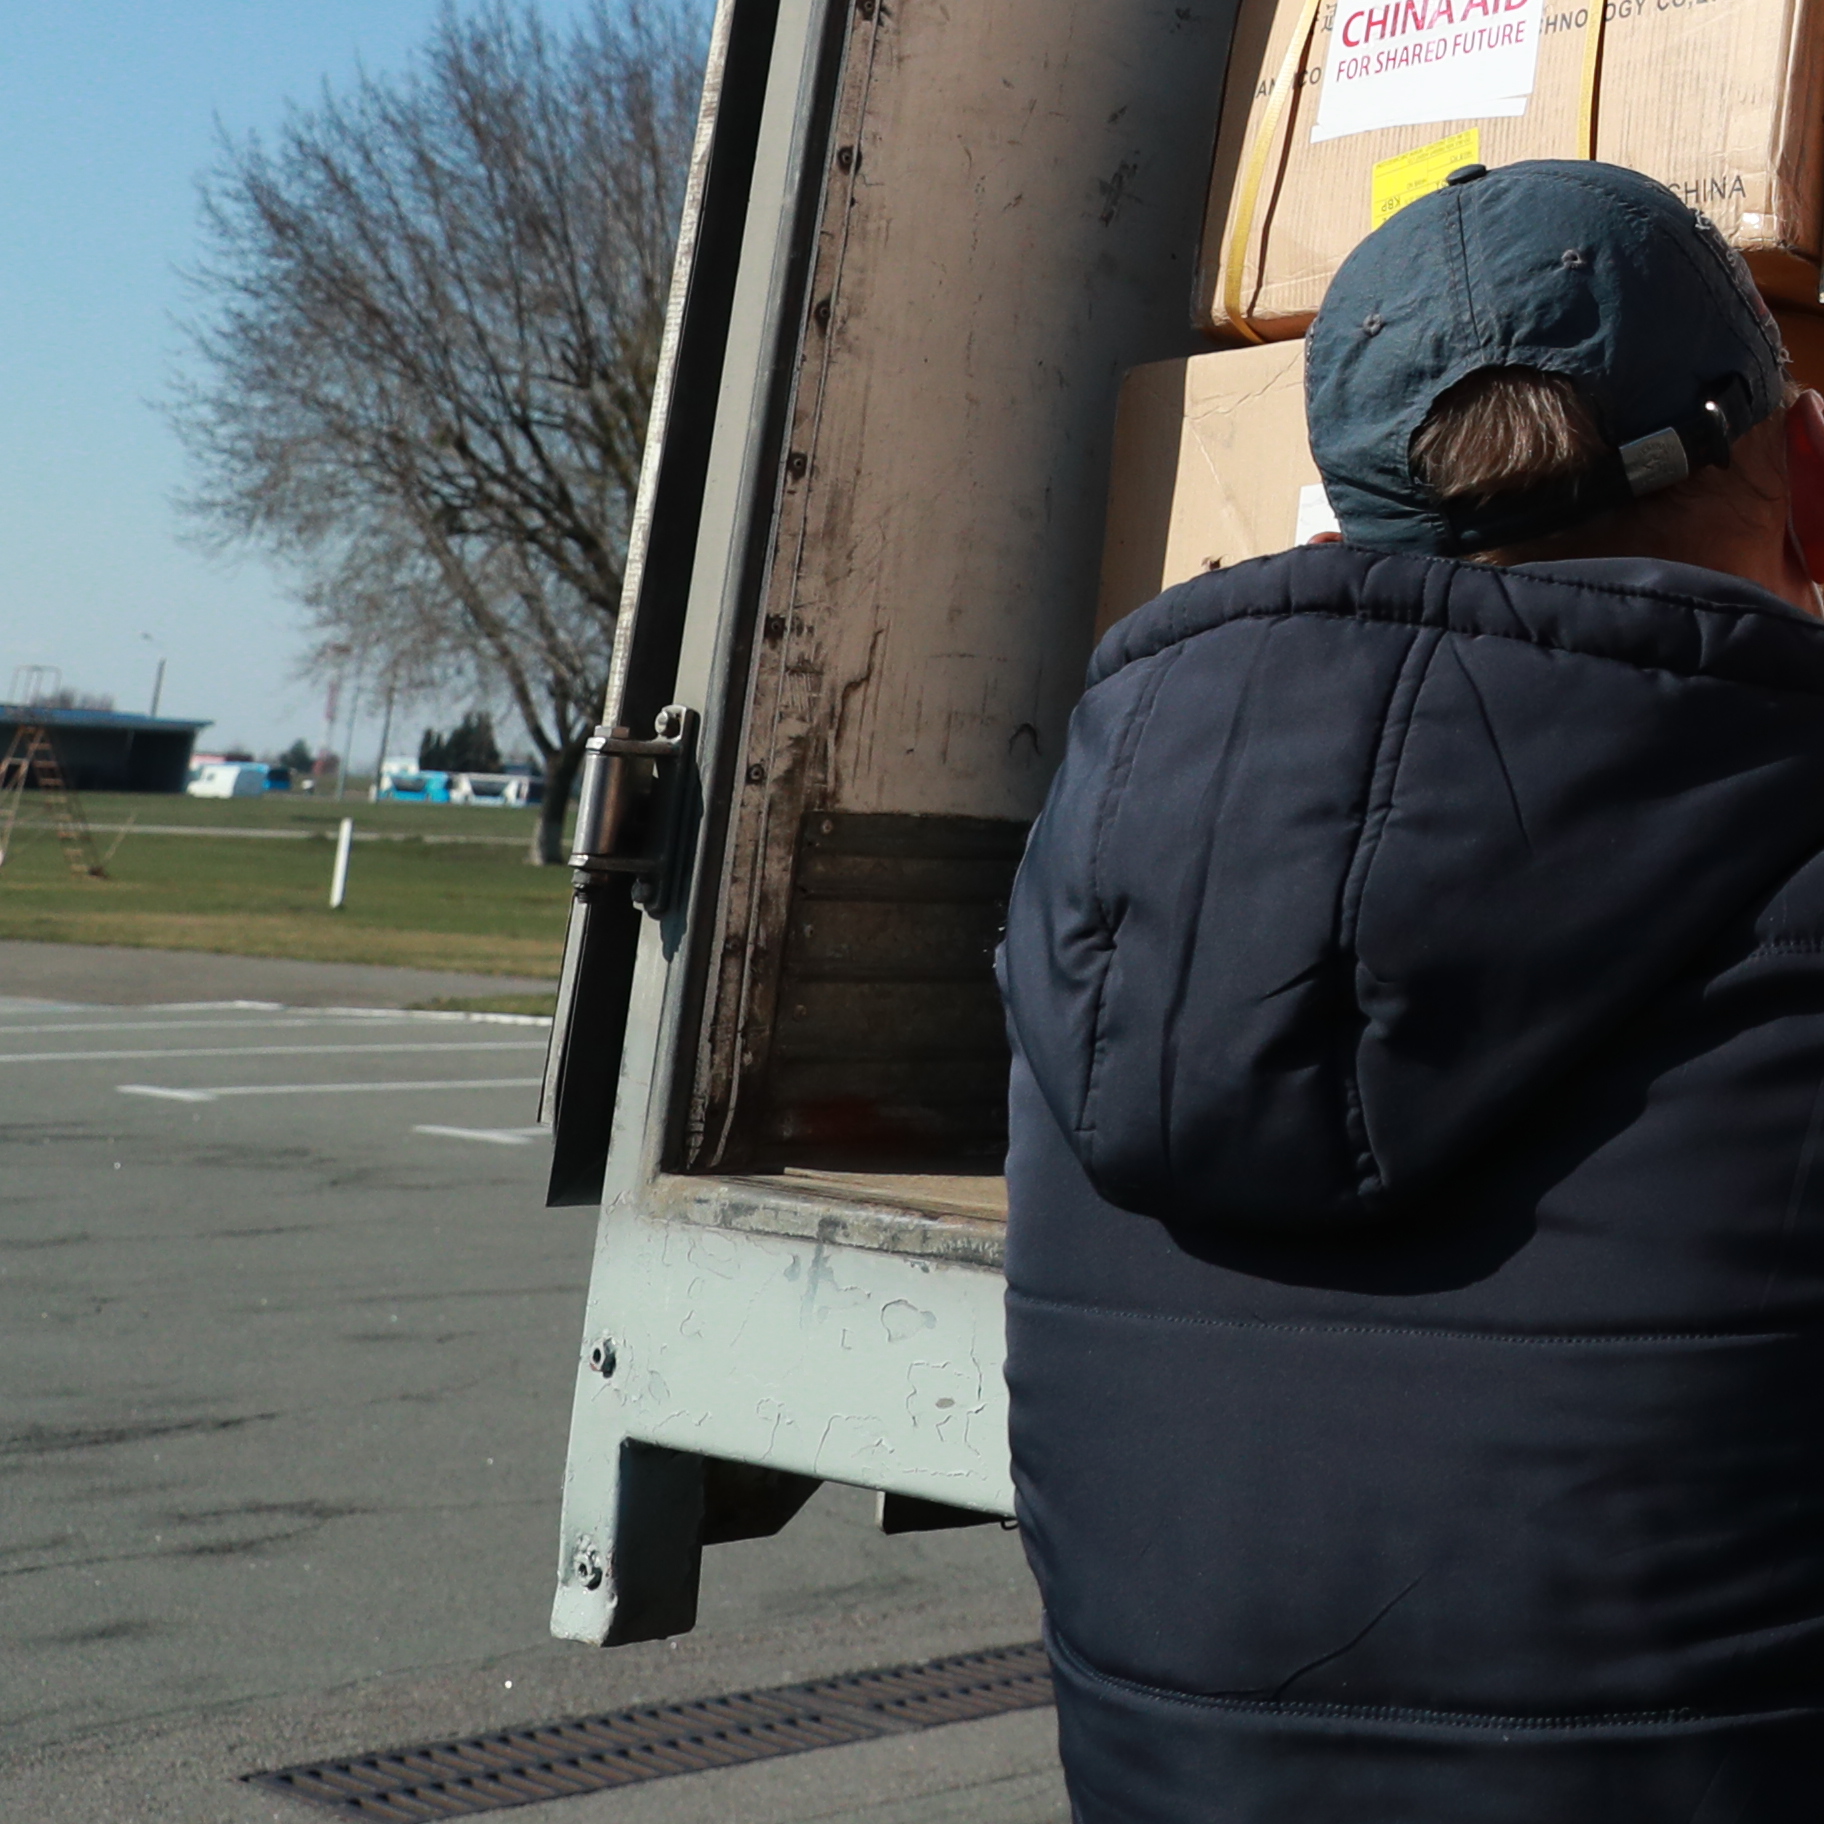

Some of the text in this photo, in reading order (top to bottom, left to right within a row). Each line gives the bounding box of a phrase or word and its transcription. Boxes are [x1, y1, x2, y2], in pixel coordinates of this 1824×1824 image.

[1336, 20, 1527, 83] FOR SHARED FUTURE
